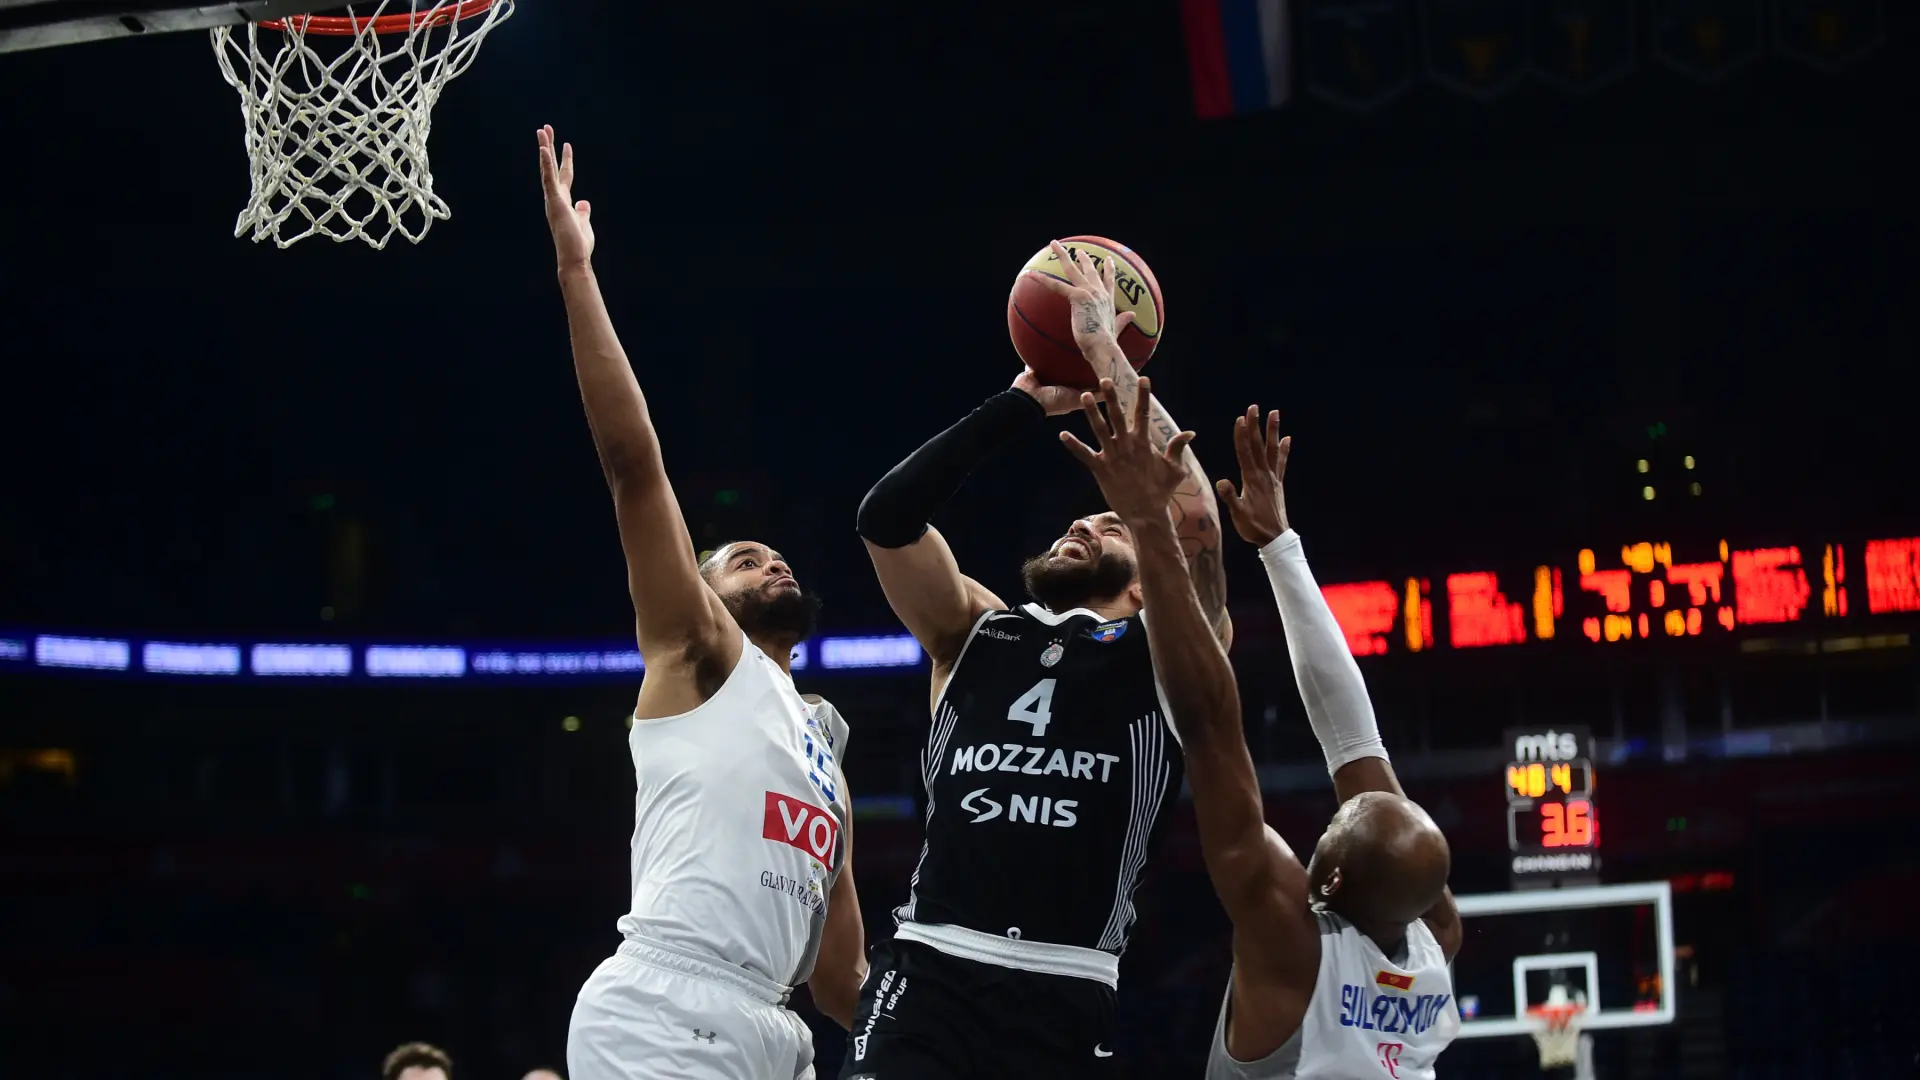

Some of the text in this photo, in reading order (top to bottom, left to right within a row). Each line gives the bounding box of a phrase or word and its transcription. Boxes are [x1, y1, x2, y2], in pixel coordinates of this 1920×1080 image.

[983, 627, 1022, 641] AikBank
[1007, 678, 1057, 736] 4
[1515, 730, 1578, 762] mts
[950, 743, 1120, 783] MOZZART
[1008, 794, 1079, 828] NIS
[760, 870, 796, 896] GLAVNI
